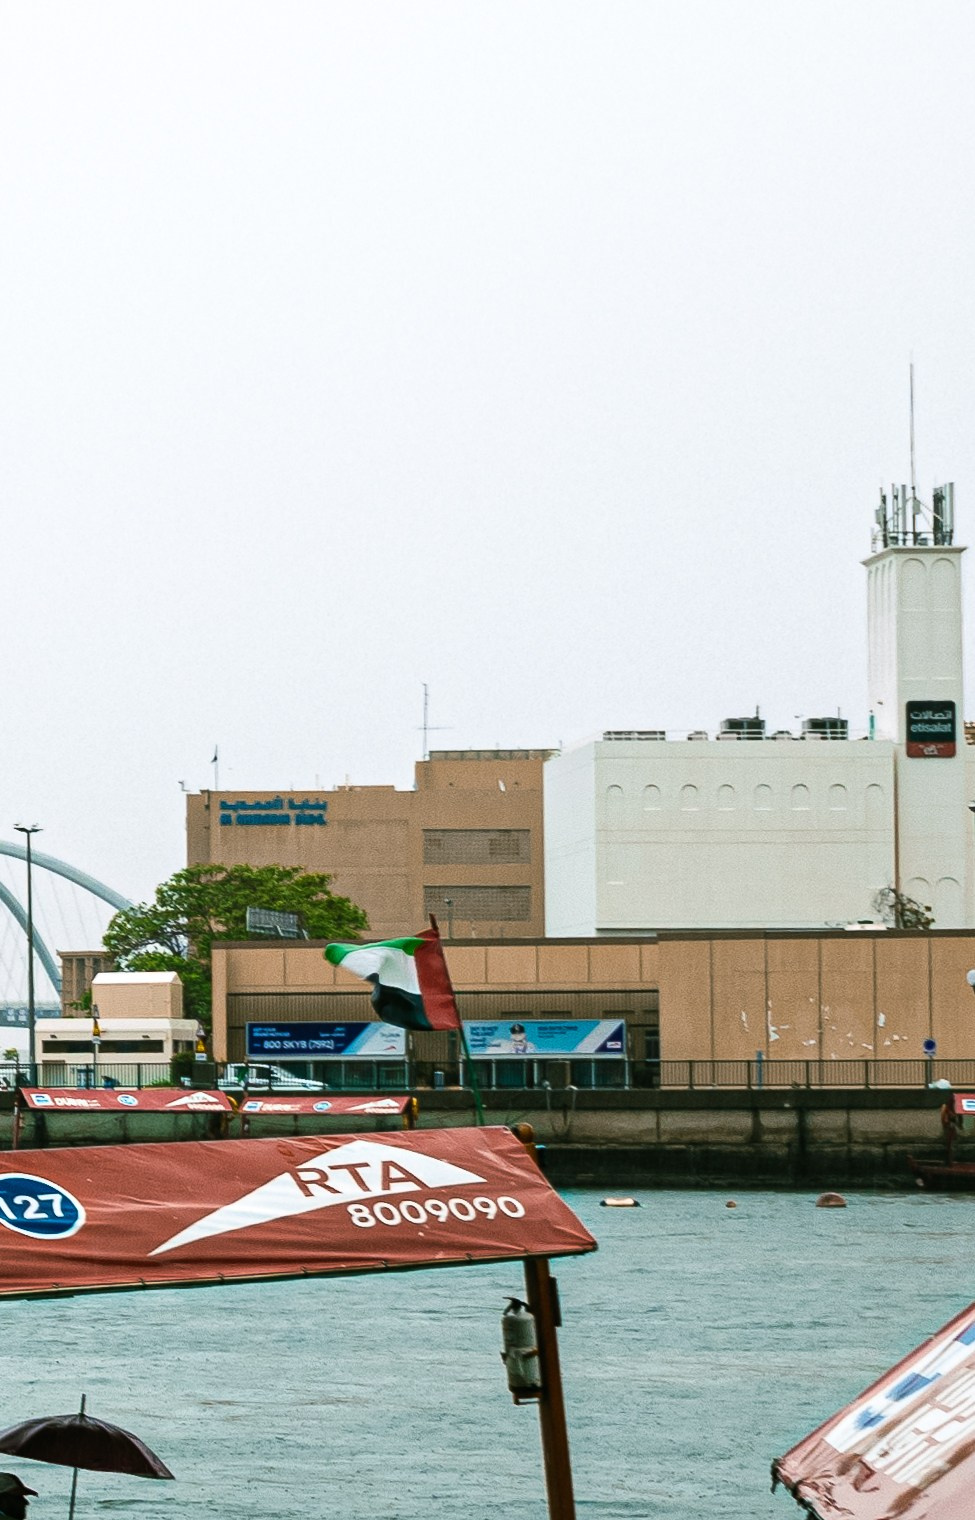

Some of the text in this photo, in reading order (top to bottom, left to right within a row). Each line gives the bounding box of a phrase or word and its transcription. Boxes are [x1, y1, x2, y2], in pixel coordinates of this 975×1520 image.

[910, 722, 952, 733] etisalat
[263, 1040, 281, 1049] 800
[287, 1159, 431, 1198] RTA
[346, 1195, 526, 1228] 8009090
